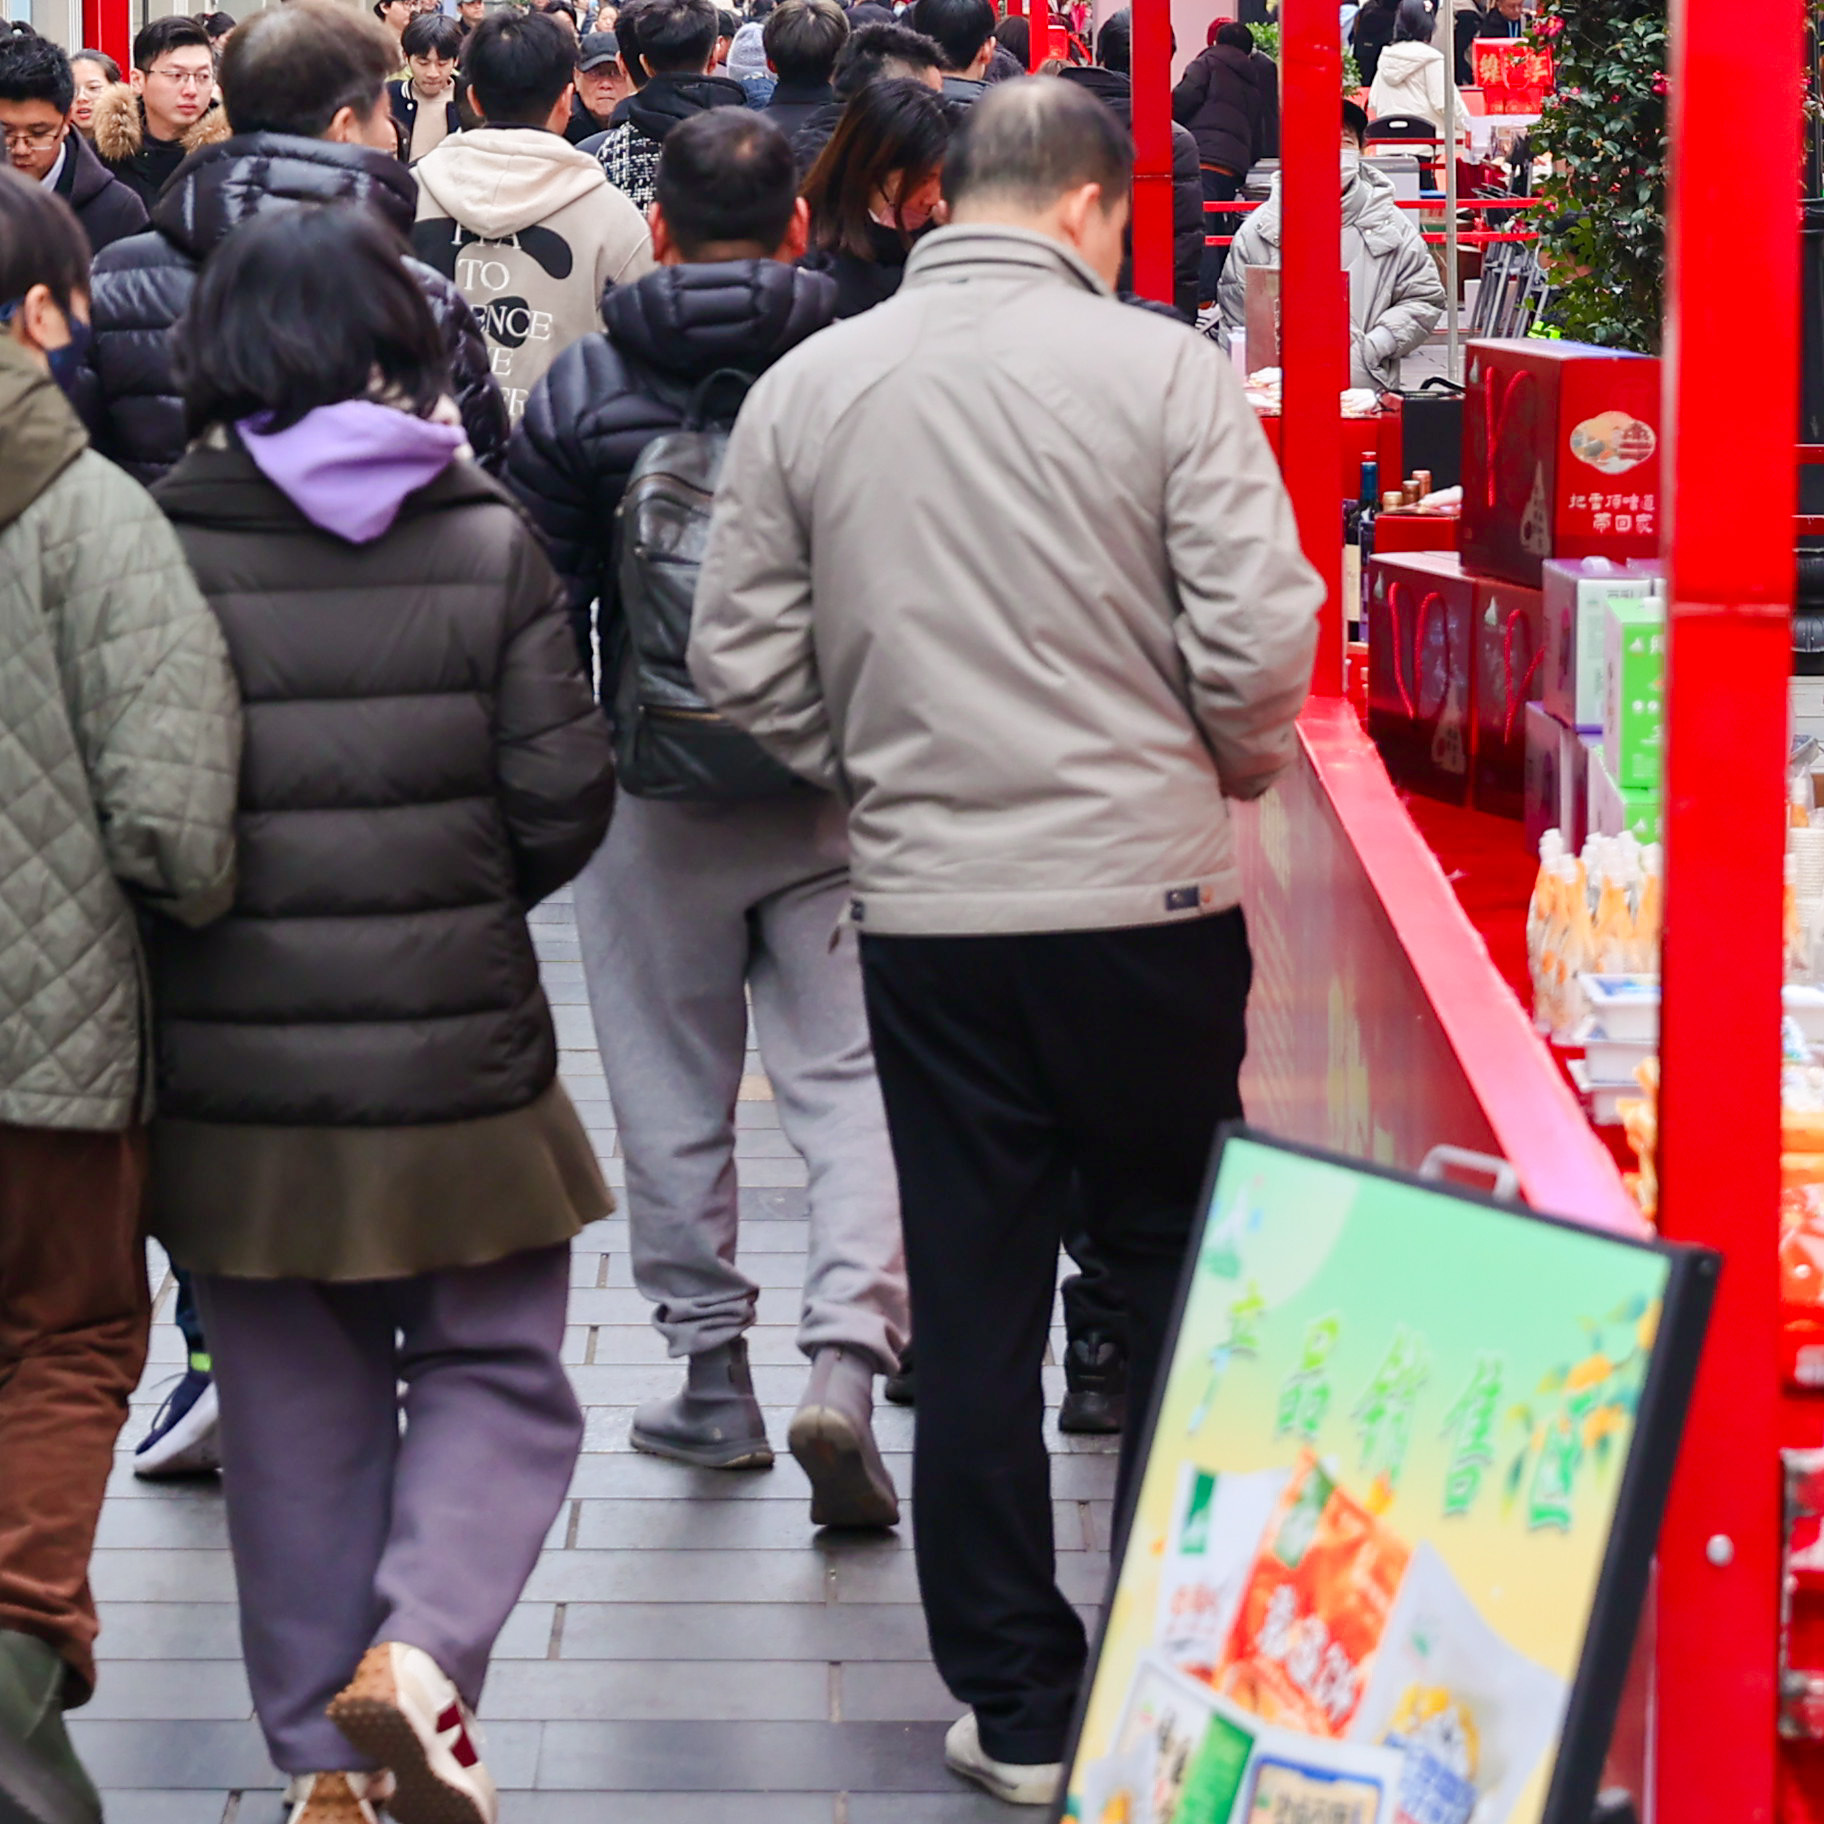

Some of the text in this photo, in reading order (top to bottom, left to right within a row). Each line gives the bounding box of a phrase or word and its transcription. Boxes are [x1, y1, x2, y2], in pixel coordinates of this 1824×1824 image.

[458, 258, 510, 291] TO
[1592, 512, 1654, 534] 带回家
